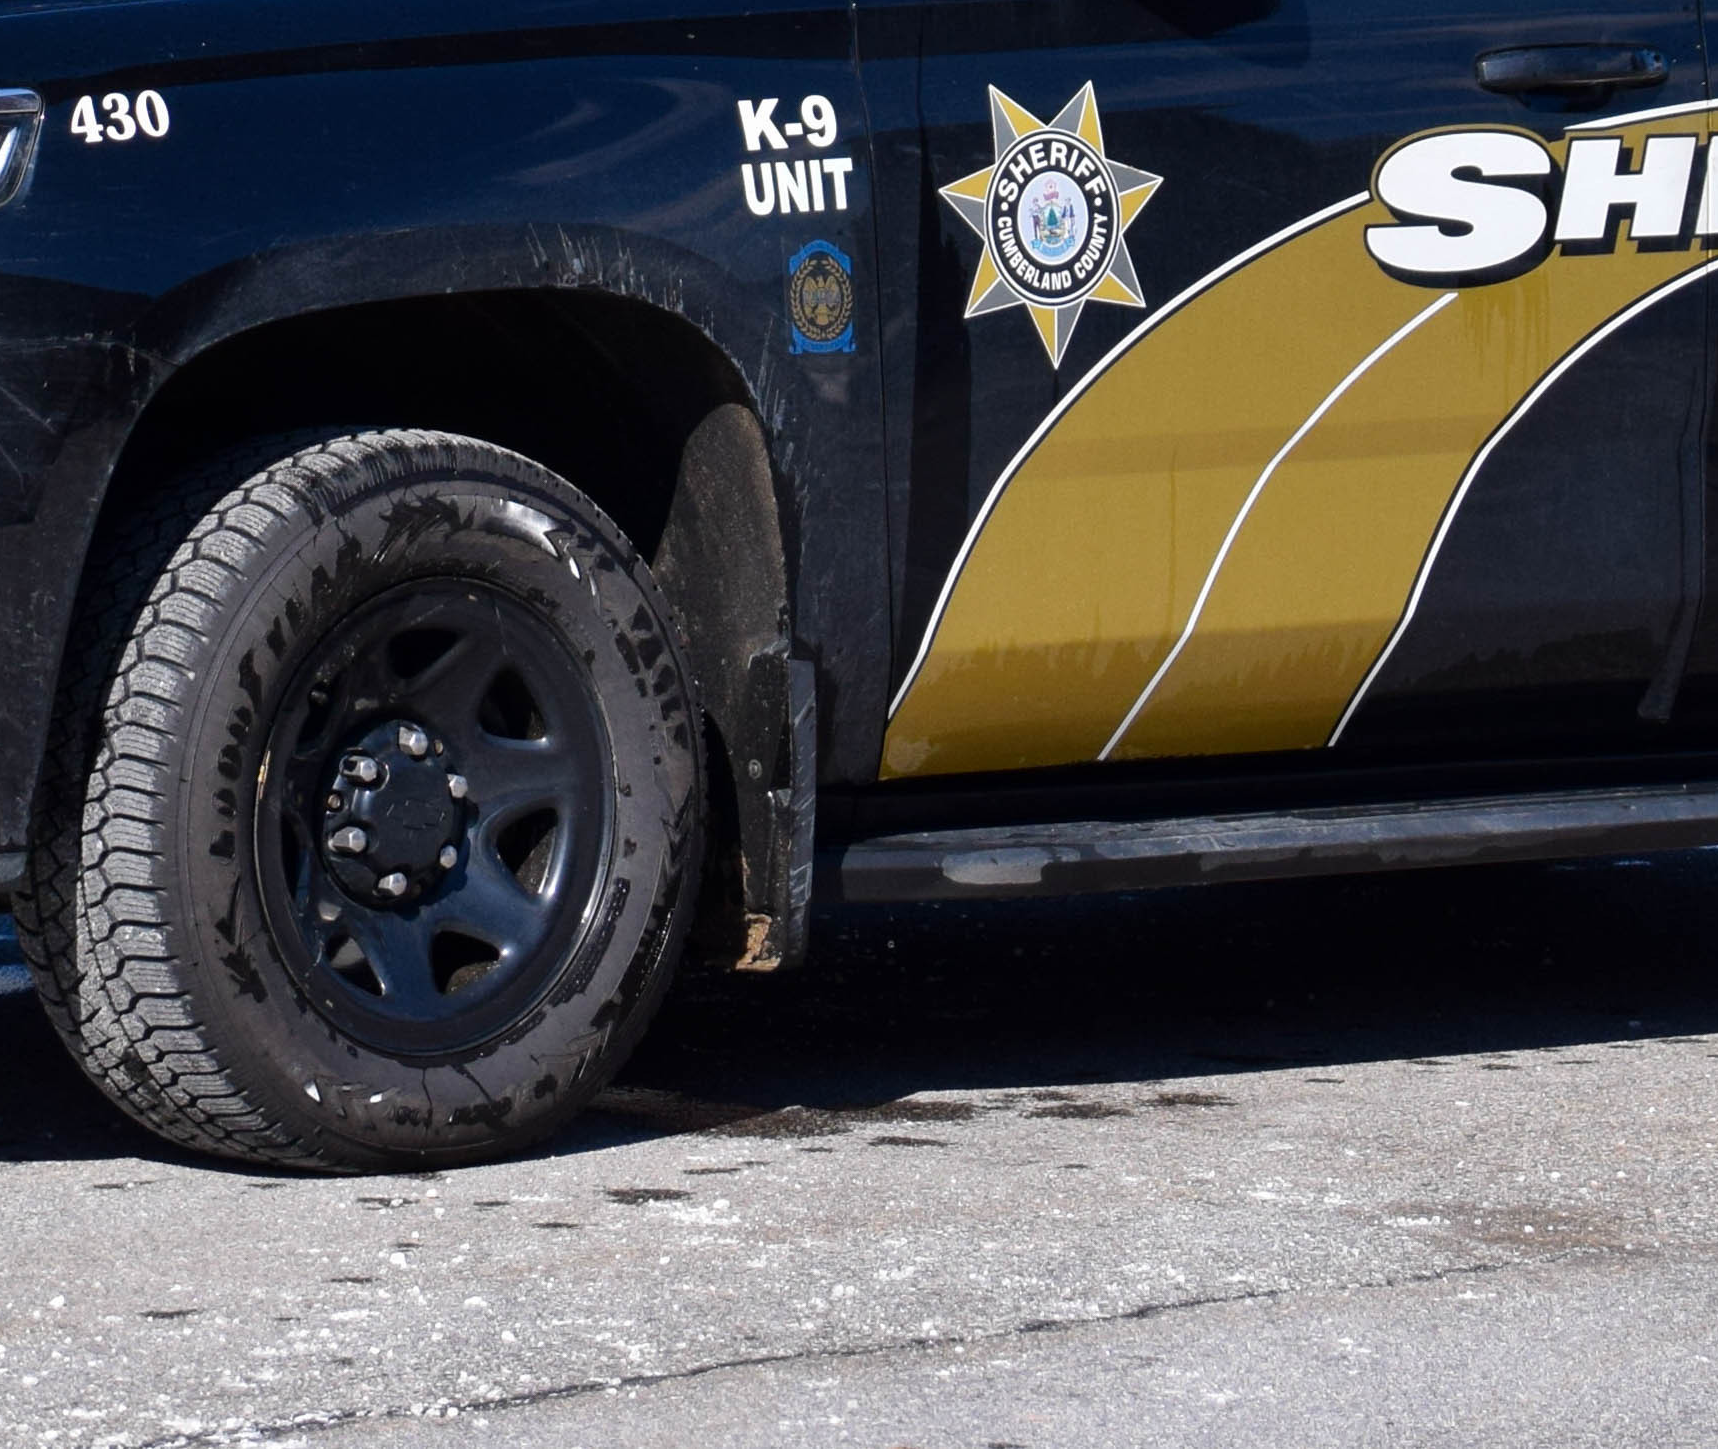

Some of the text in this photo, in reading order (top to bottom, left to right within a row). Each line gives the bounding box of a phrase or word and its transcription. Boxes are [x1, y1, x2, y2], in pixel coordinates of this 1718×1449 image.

[70, 89, 170, 144] 430
[737, 94, 838, 152] K-9
[741, 157, 853, 216] UNIT
[998, 140, 1107, 203] SHERIFF
[997, 212, 1108, 291] CUMBERLAND COUNTY
